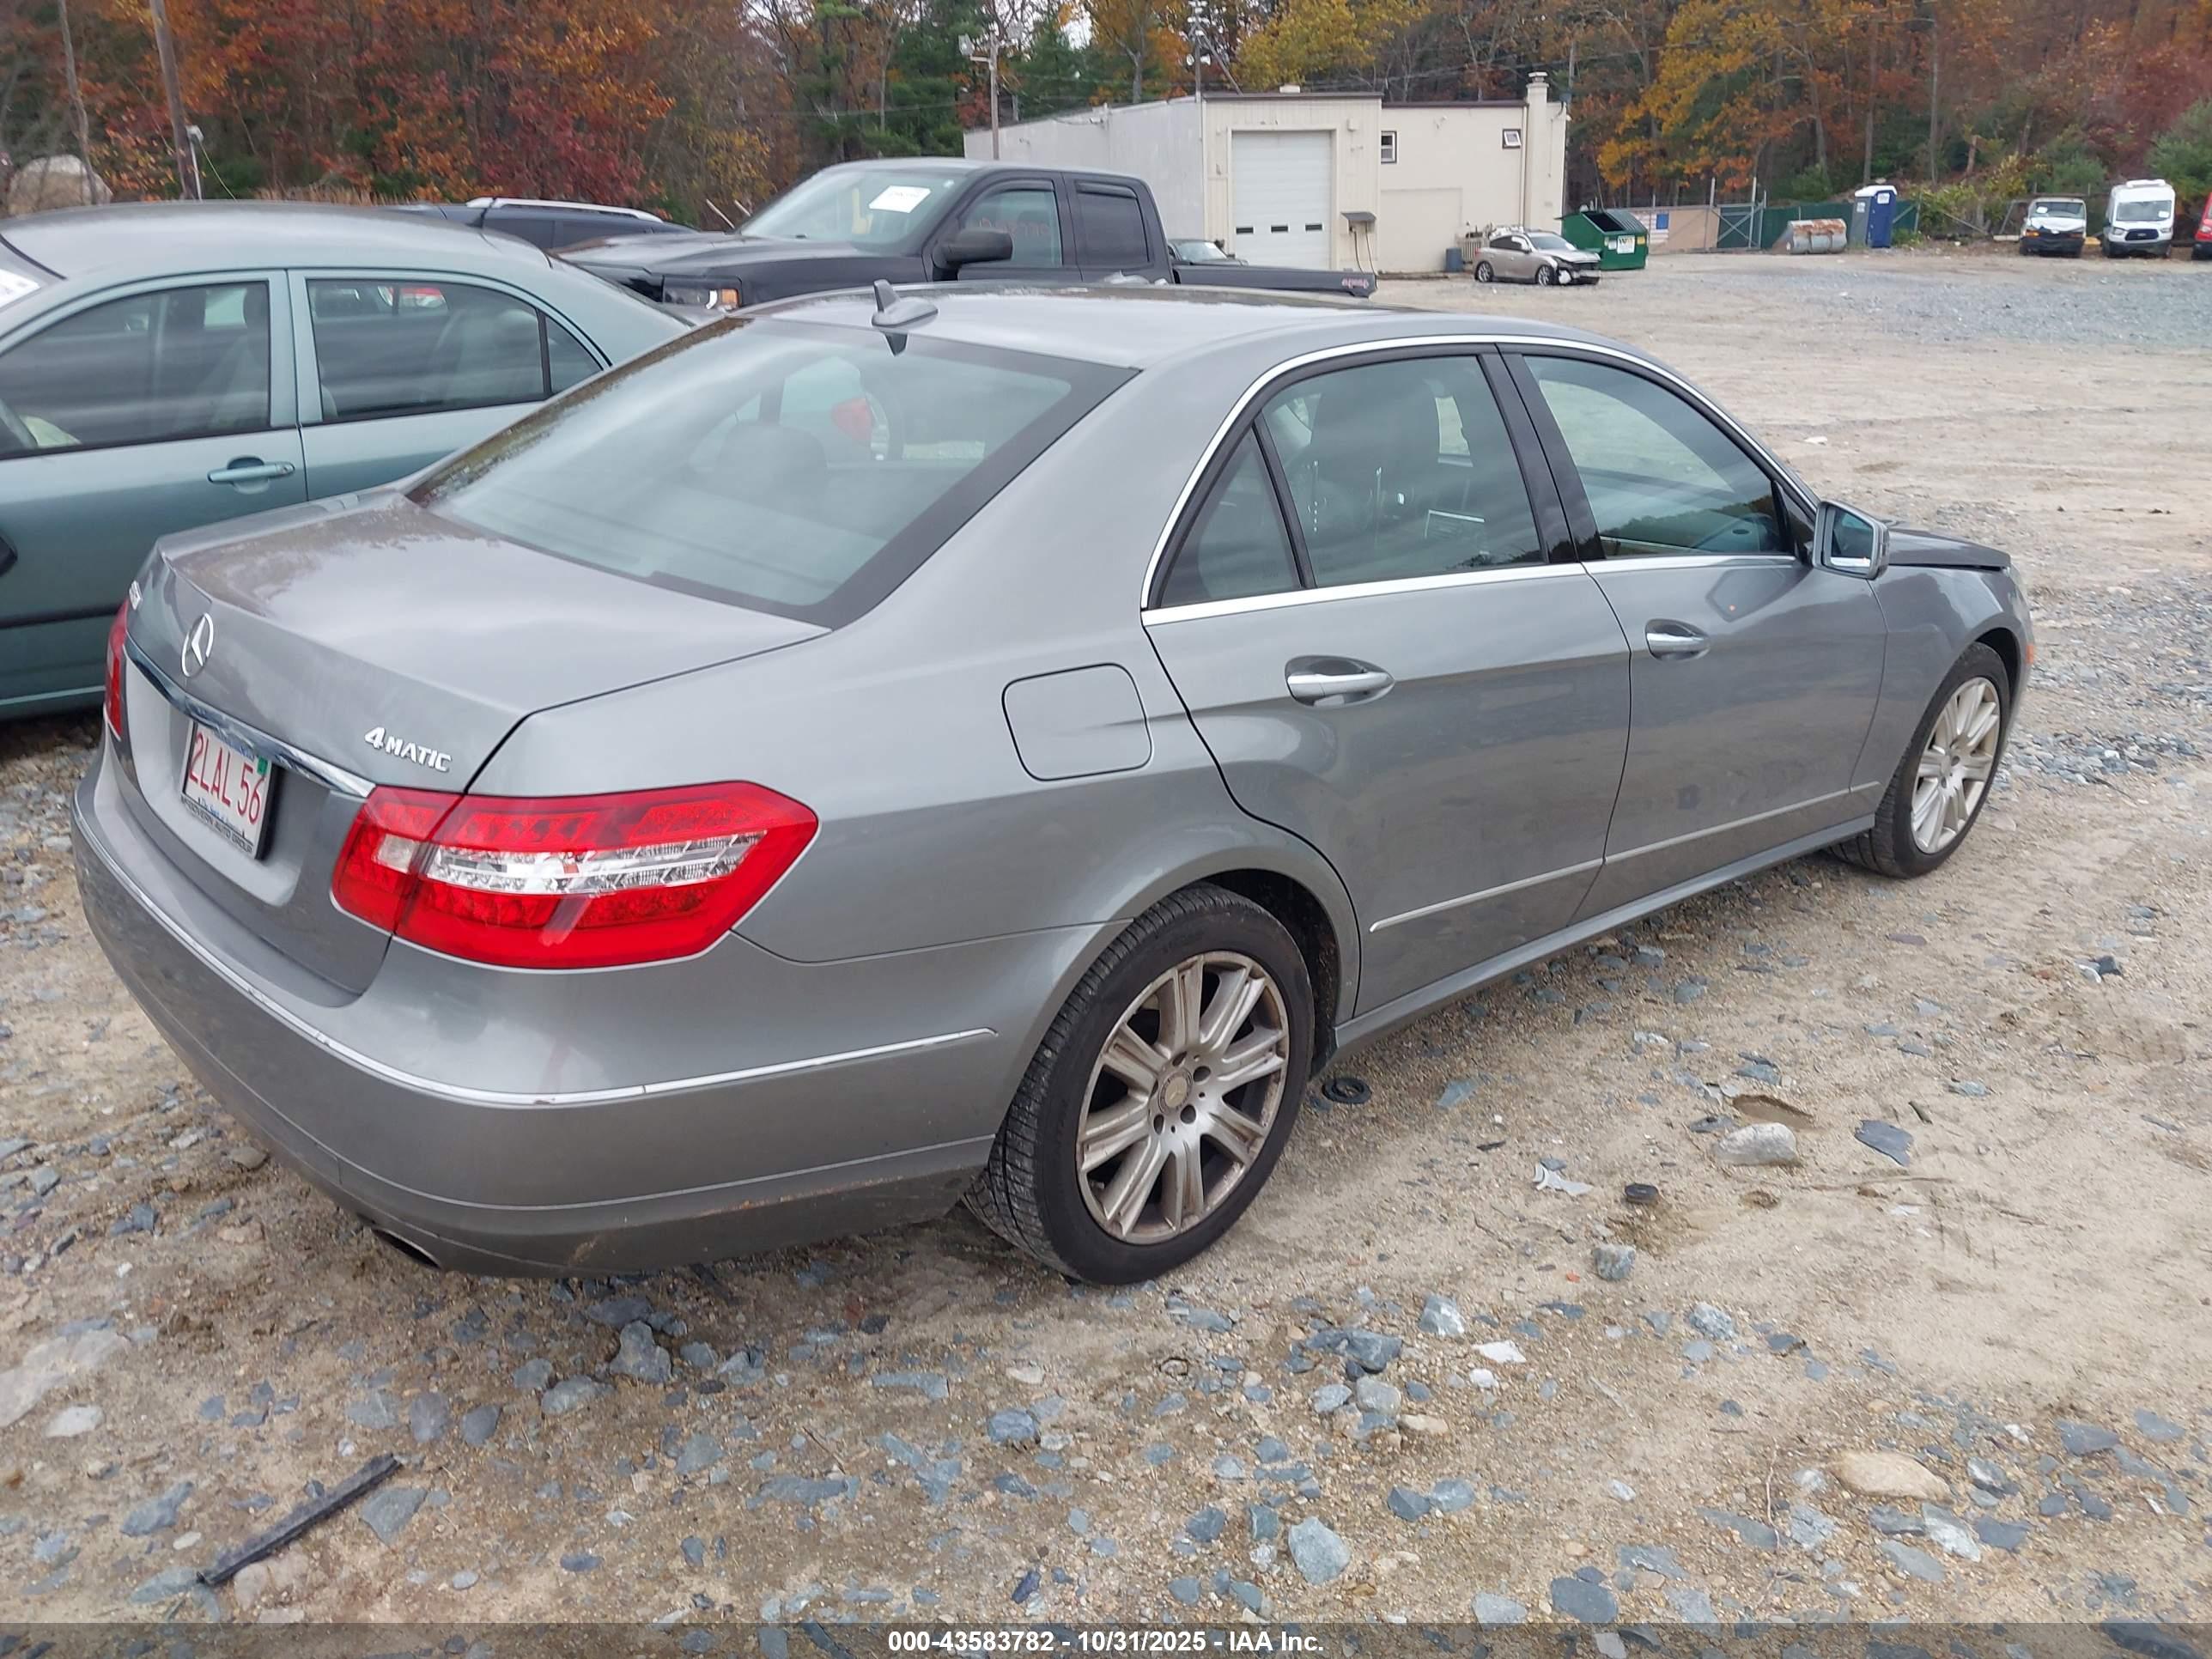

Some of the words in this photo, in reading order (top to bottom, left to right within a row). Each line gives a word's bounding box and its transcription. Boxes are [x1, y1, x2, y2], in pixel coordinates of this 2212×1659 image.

[189, 732, 231, 807] 2LAL
[237, 763, 265, 824] 56
[364, 726, 452, 771] 4MATIC
